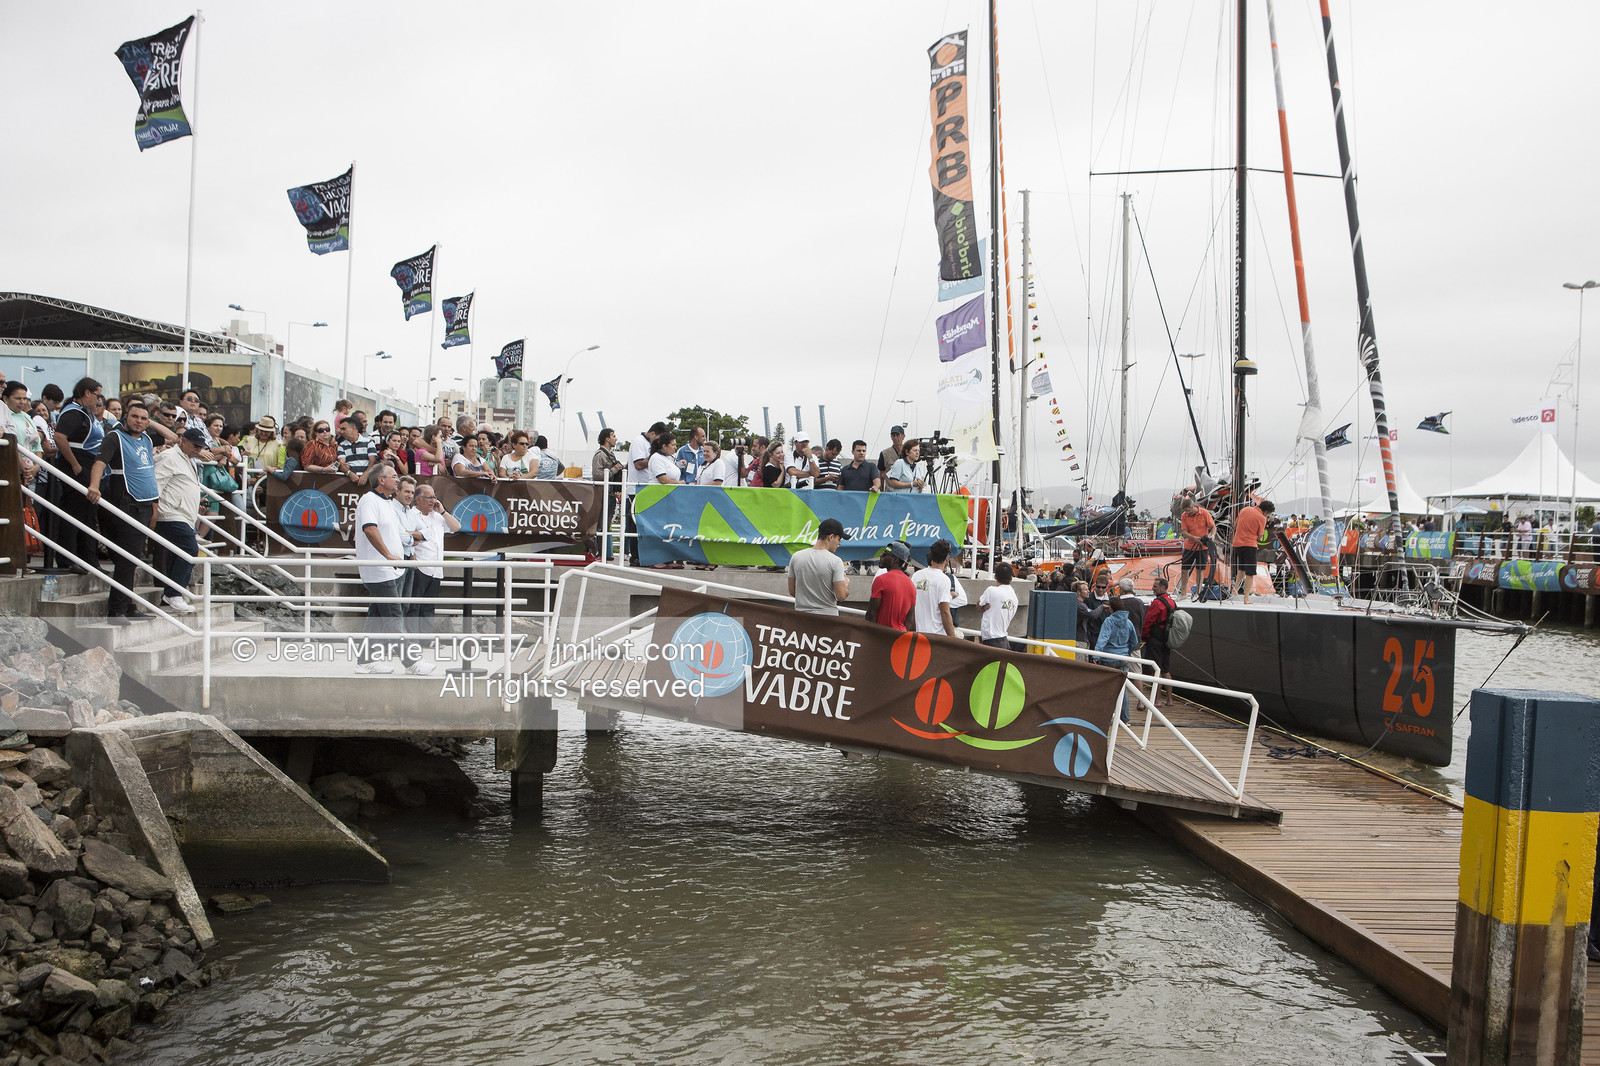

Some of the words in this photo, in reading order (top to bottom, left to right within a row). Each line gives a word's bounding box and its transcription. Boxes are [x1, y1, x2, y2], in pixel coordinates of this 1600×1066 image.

[936, 81, 968, 190] PRB
[507, 498, 583, 513] TRANSAT
[882, 524, 894, 538] a
[899, 512, 941, 539] terra
[755, 624, 861, 659] TRANSAT
[742, 664, 855, 721] VABRE
[1382, 637, 1435, 718] 25
[1395, 722, 1435, 737] SAFRAN
